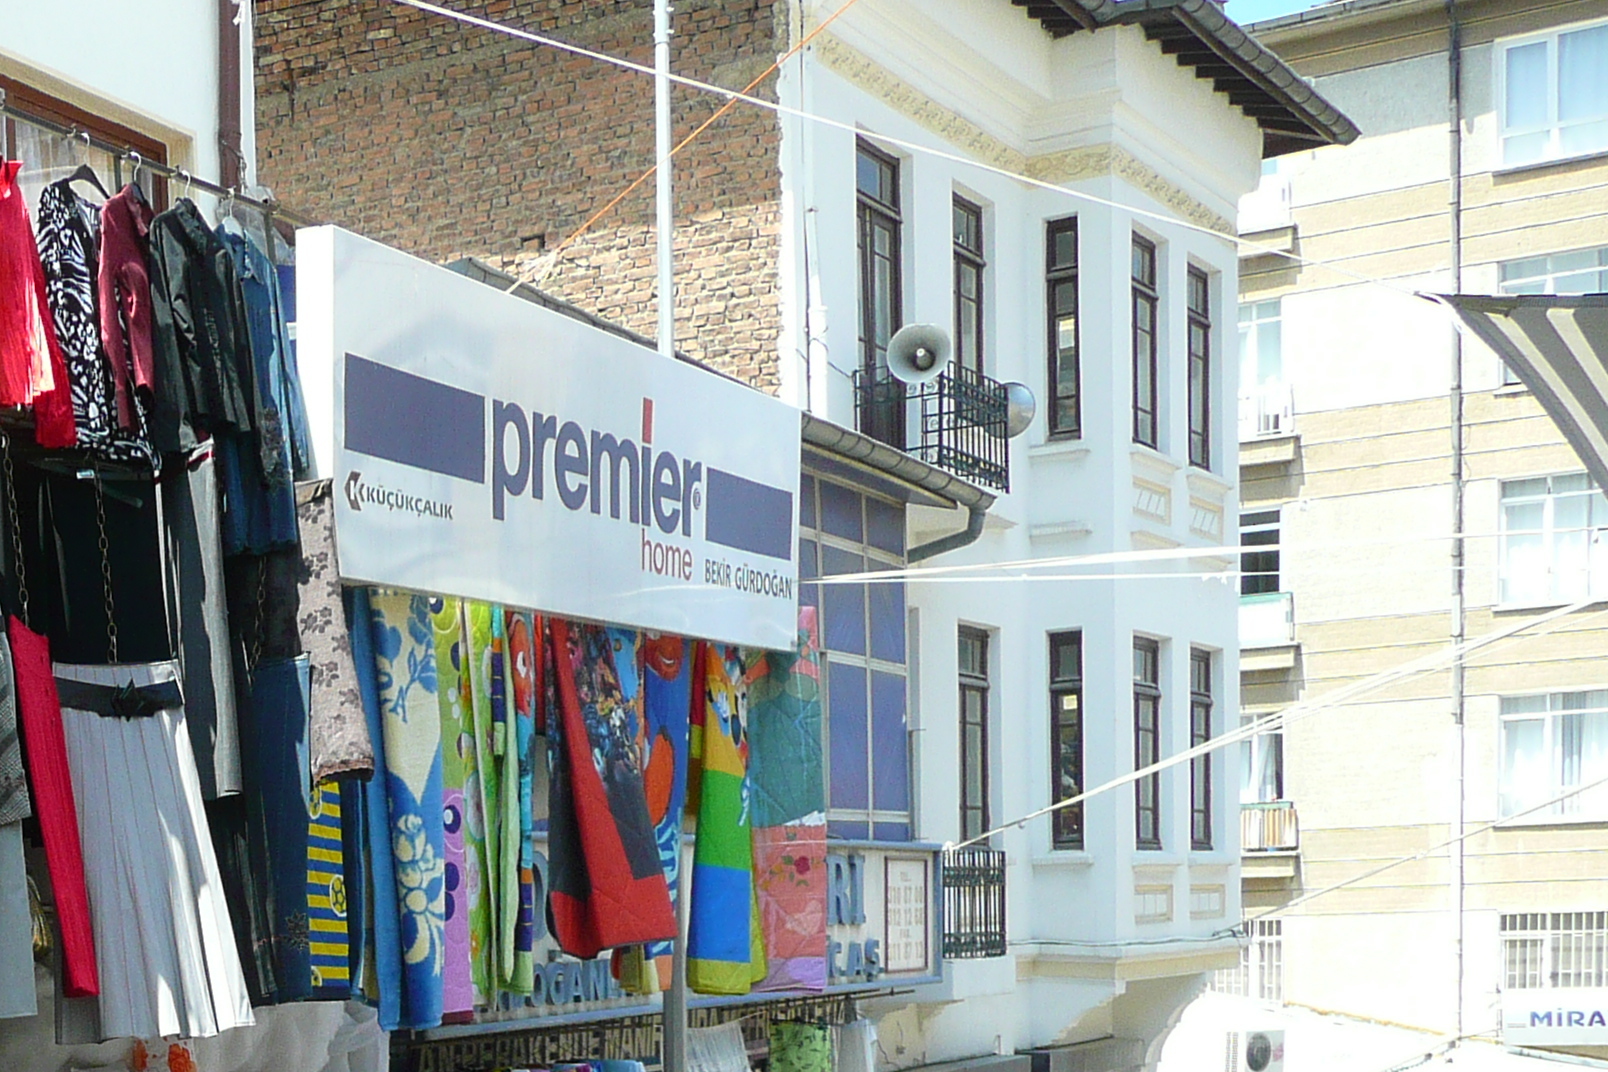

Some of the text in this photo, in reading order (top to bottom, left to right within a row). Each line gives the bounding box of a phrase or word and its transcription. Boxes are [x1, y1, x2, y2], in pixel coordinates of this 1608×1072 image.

[493, 397, 702, 537] premier
[363, 483, 453, 520] KÜÇÜKÇALIK
[642, 528, 692, 581] home
[704, 557, 793, 600] BEKİR GÜRDOĞAN
